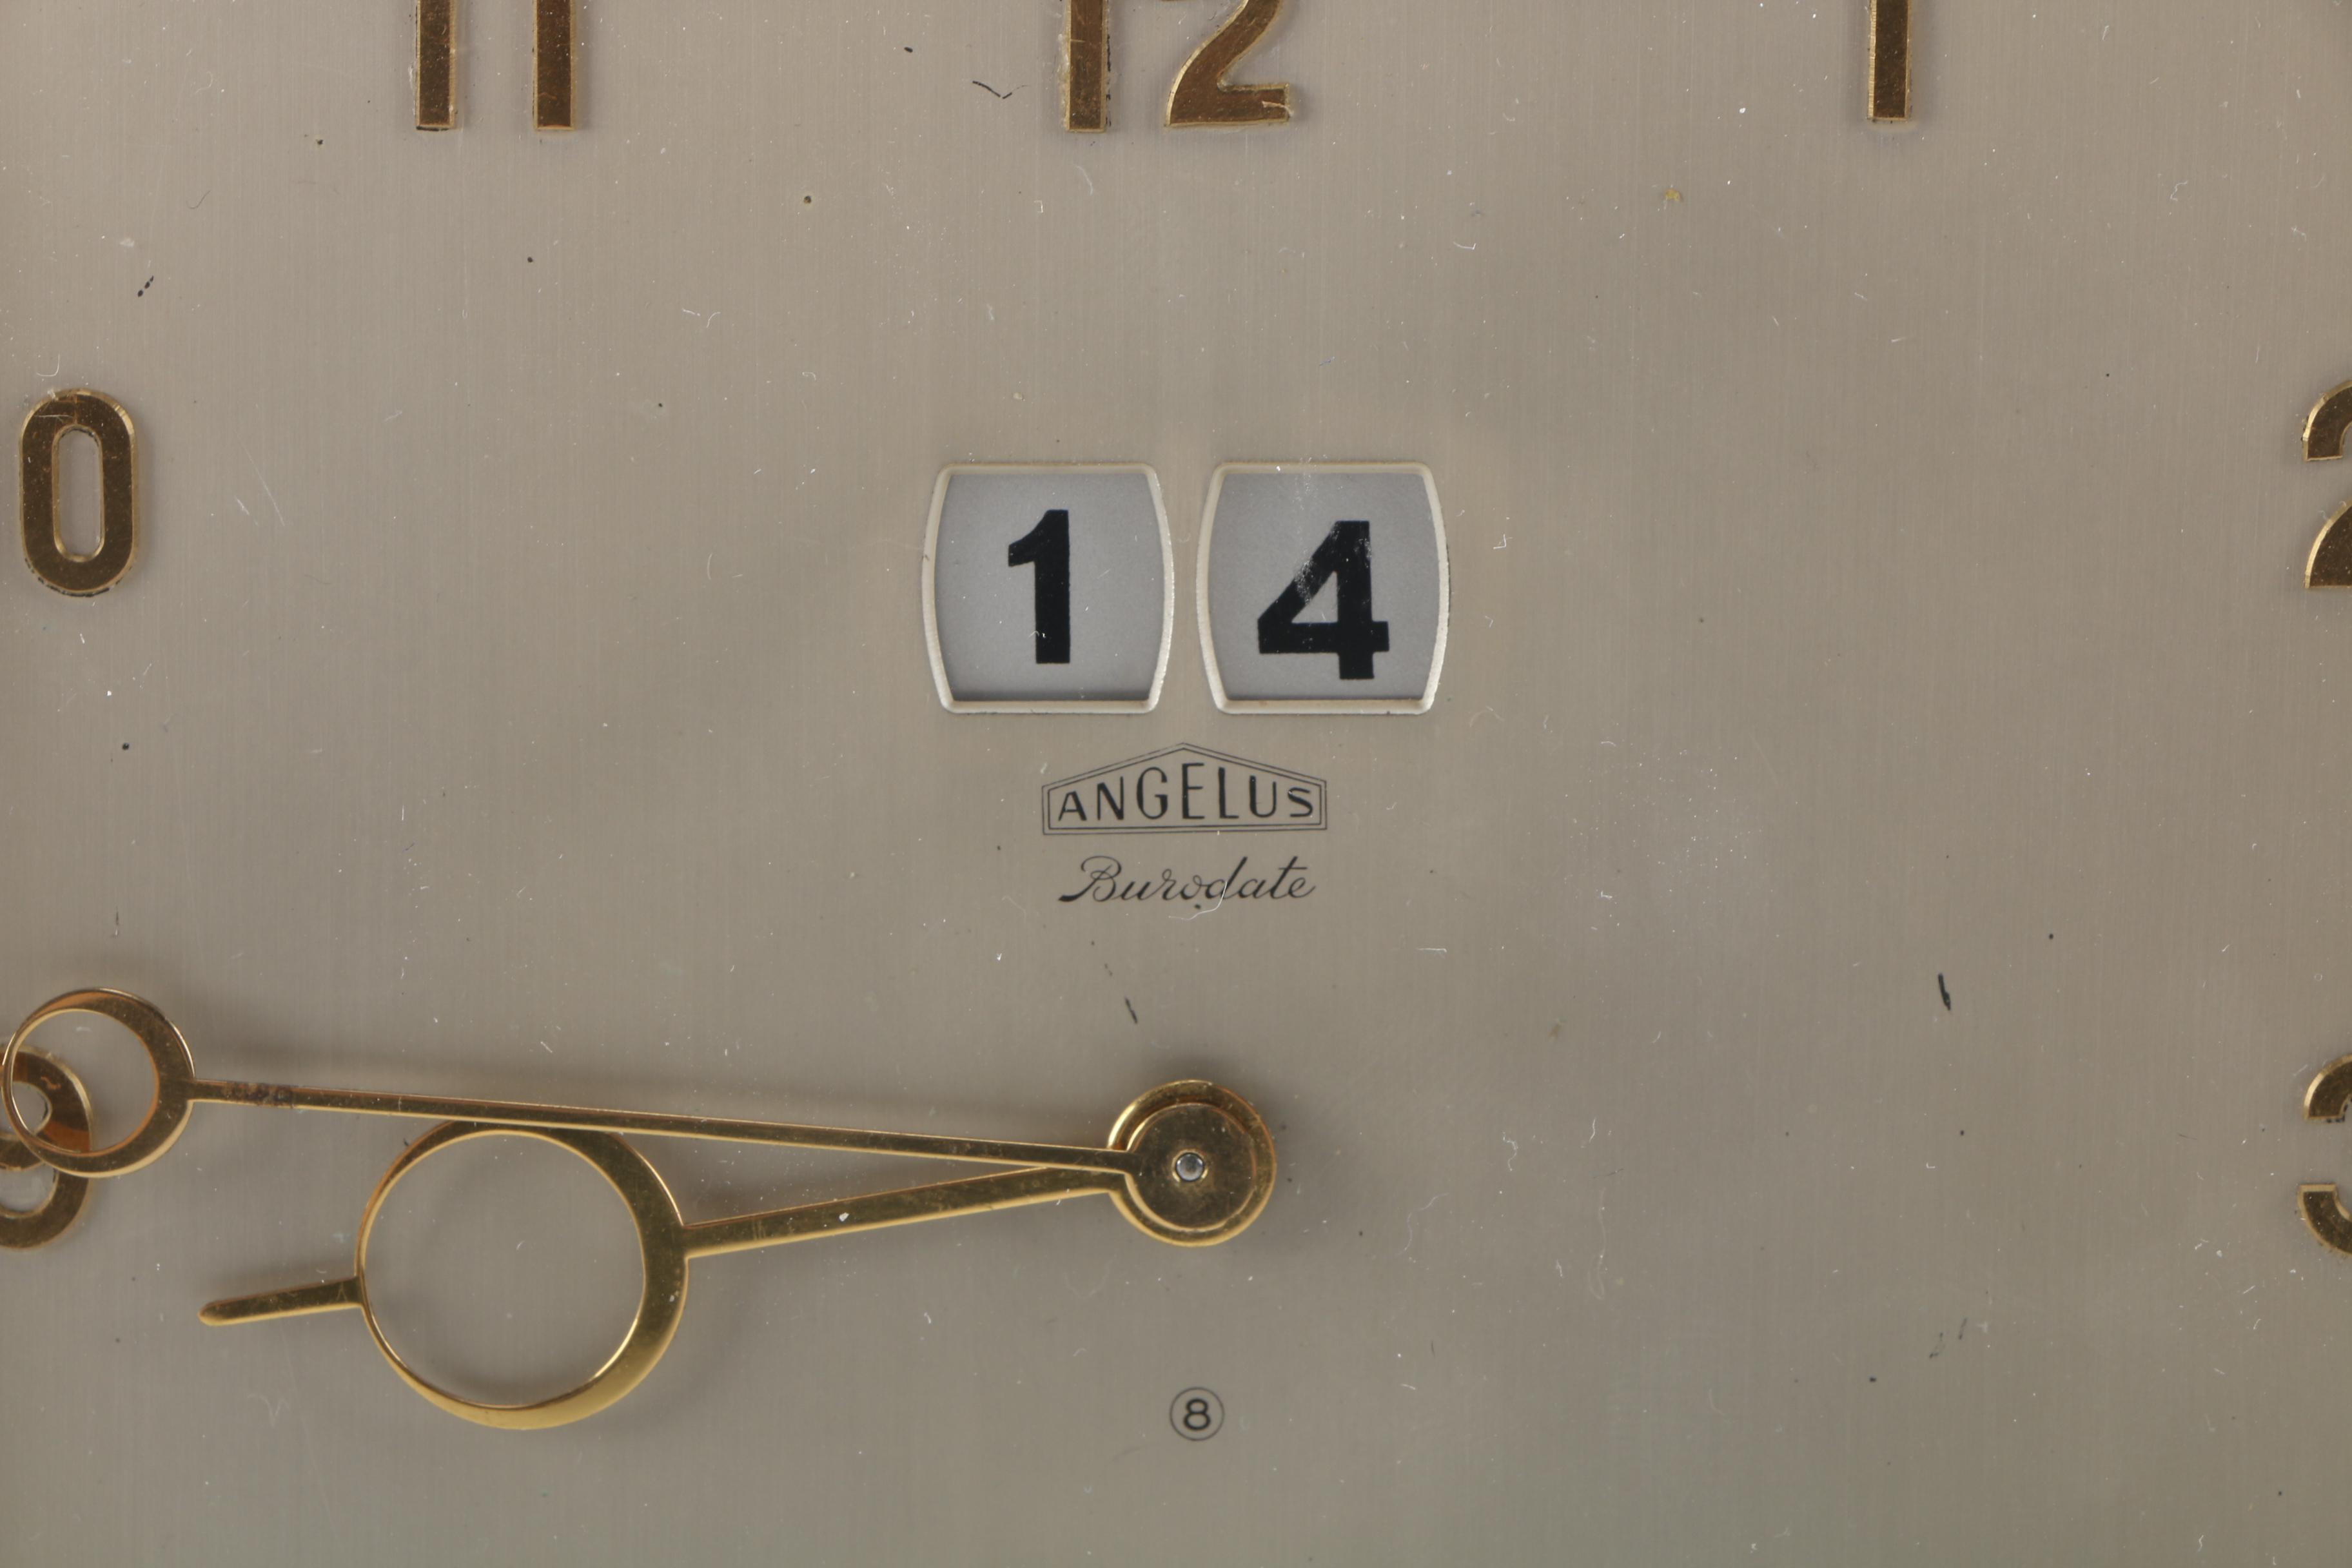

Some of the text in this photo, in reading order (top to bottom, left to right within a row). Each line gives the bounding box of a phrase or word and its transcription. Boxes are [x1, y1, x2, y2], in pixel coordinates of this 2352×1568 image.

[1065, 0, 1292, 132] 12
[1057, 762, 1314, 821] ANGELUS
[1057, 855, 1317, 902] Burodate
[1183, 1398, 1211, 1431] 8
